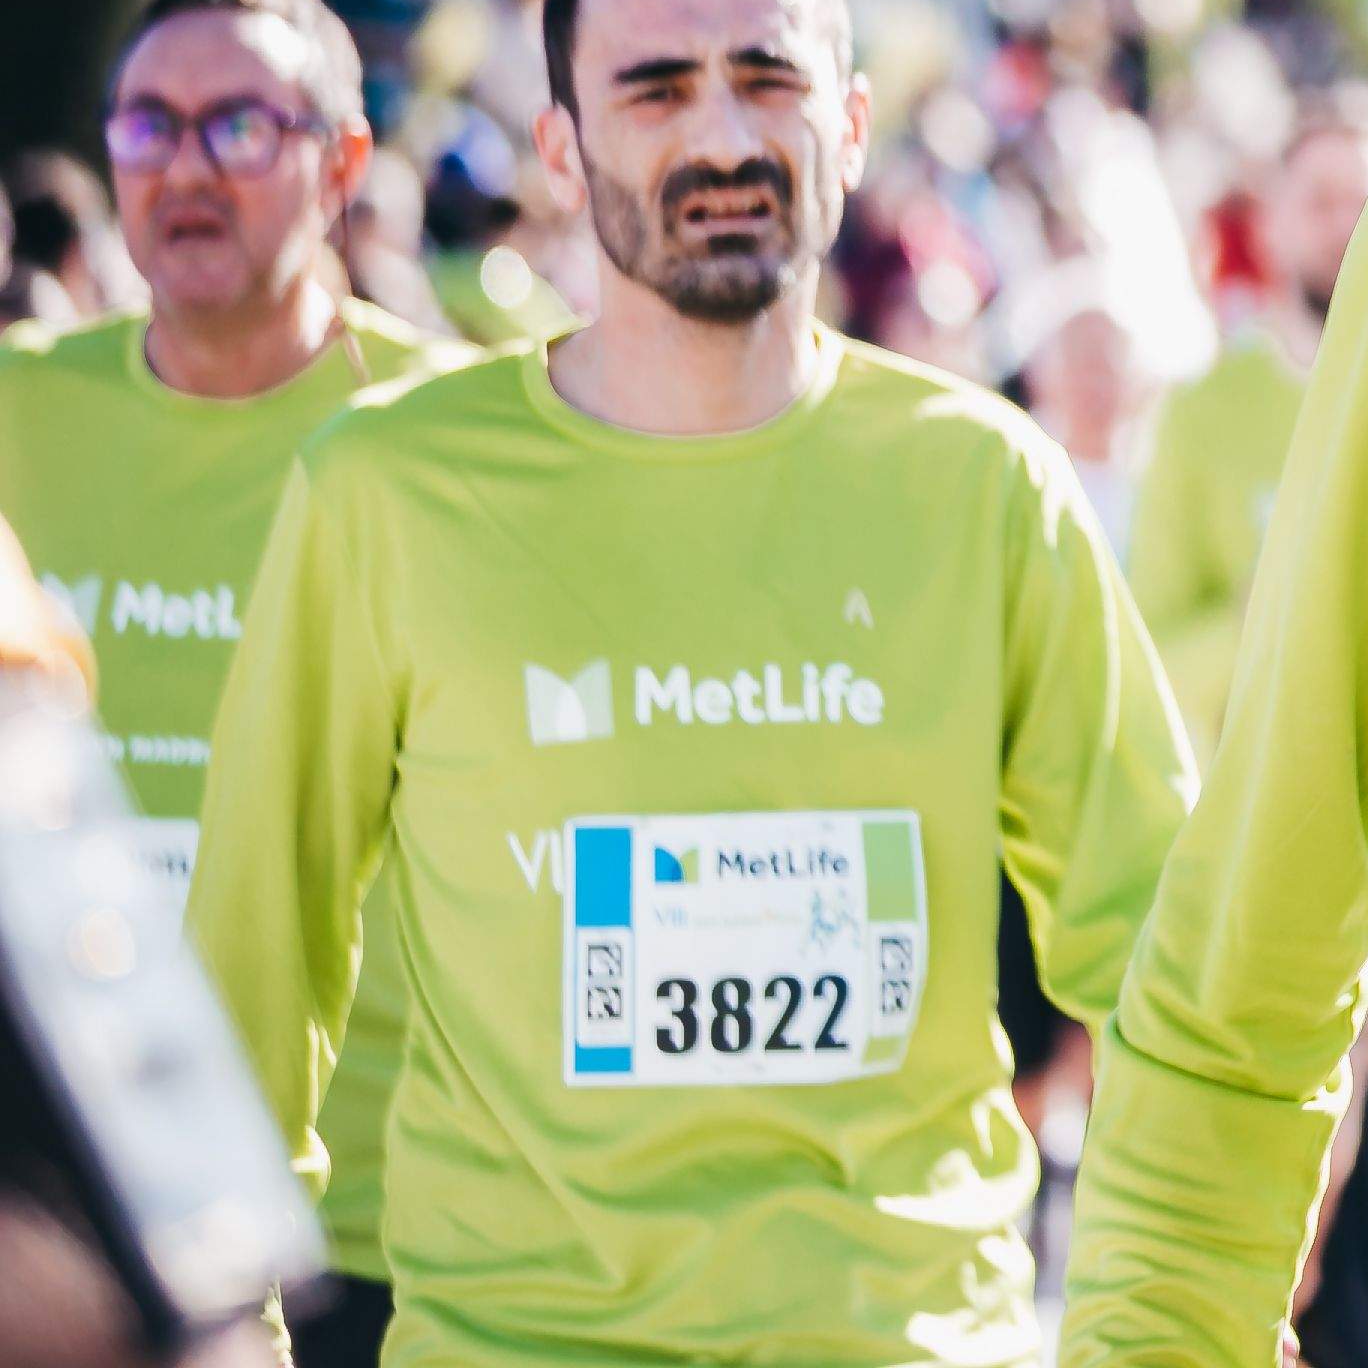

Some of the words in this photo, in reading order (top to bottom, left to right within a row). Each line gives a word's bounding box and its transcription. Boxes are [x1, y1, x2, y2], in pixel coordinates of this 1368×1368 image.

[634, 662, 884, 726] MetLife
[716, 847, 849, 881] MetLife
[656, 975, 850, 1053] 3822
